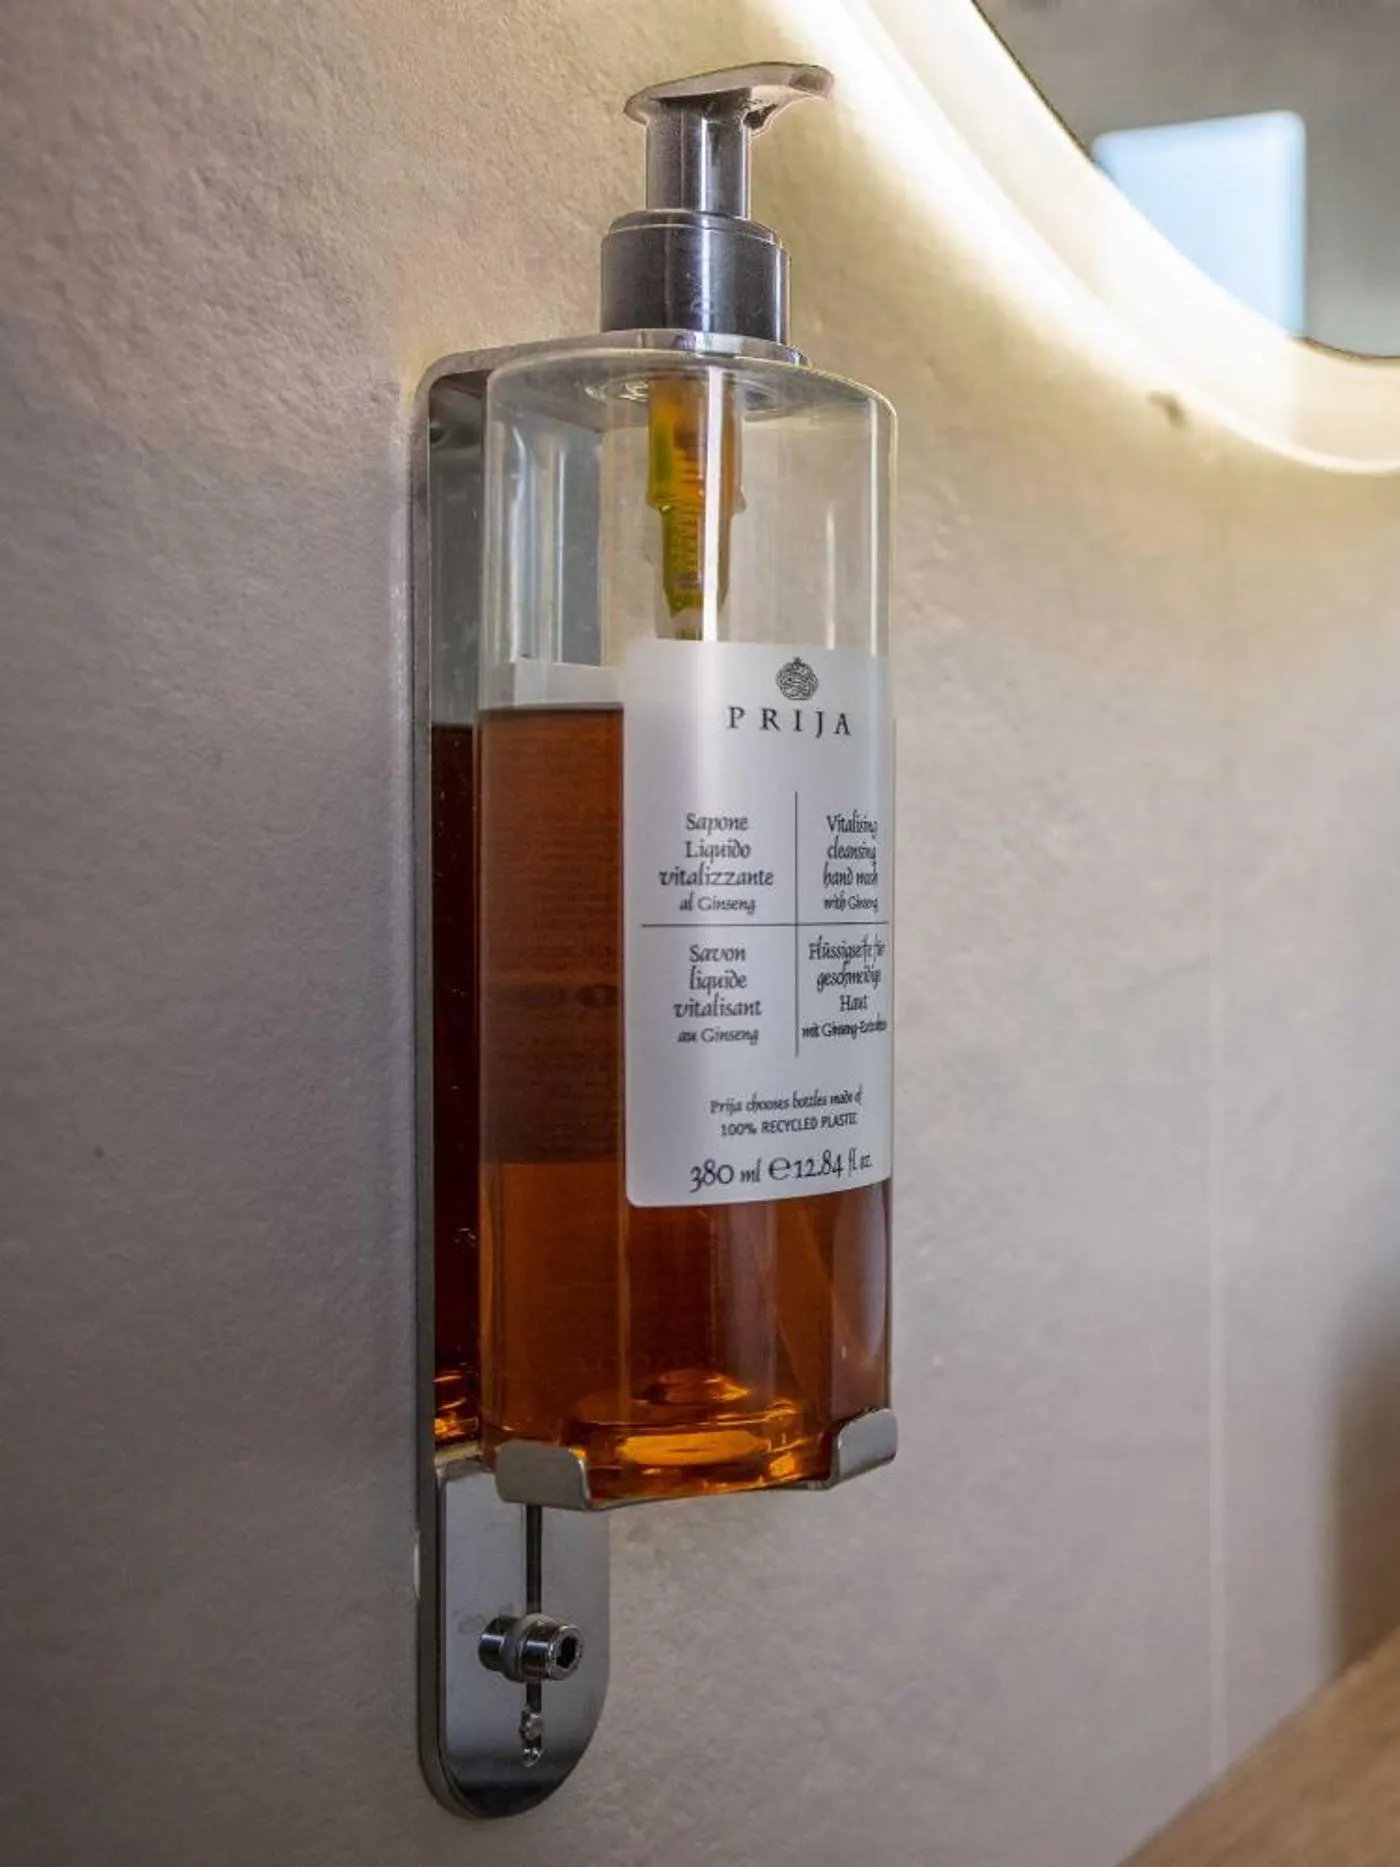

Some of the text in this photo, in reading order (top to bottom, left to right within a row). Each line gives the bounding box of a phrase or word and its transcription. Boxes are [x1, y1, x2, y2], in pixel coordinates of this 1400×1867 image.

[727, 705, 851, 739] PRIJA
[685, 812, 749, 837] Sapone
[684, 838, 752, 866] Liquido
[658, 864, 774, 888] vitalizzante
[679, 891, 756, 915] al Ginseng
[688, 944, 747, 963] Savon
[689, 965, 748, 996] liquide
[672, 993, 763, 1019] vitalisant
[677, 1027, 760, 1046] au Ginseng
[710, 1098, 743, 1117] Prija
[745, 1092, 790, 1113] chooses
[792, 1088, 828, 1109] bottles
[720, 1122, 758, 1137] 100%
[761, 1117, 819, 1135] RECYCLED
[689, 1159, 735, 1193] 380
[739, 1156, 761, 1184] ml
